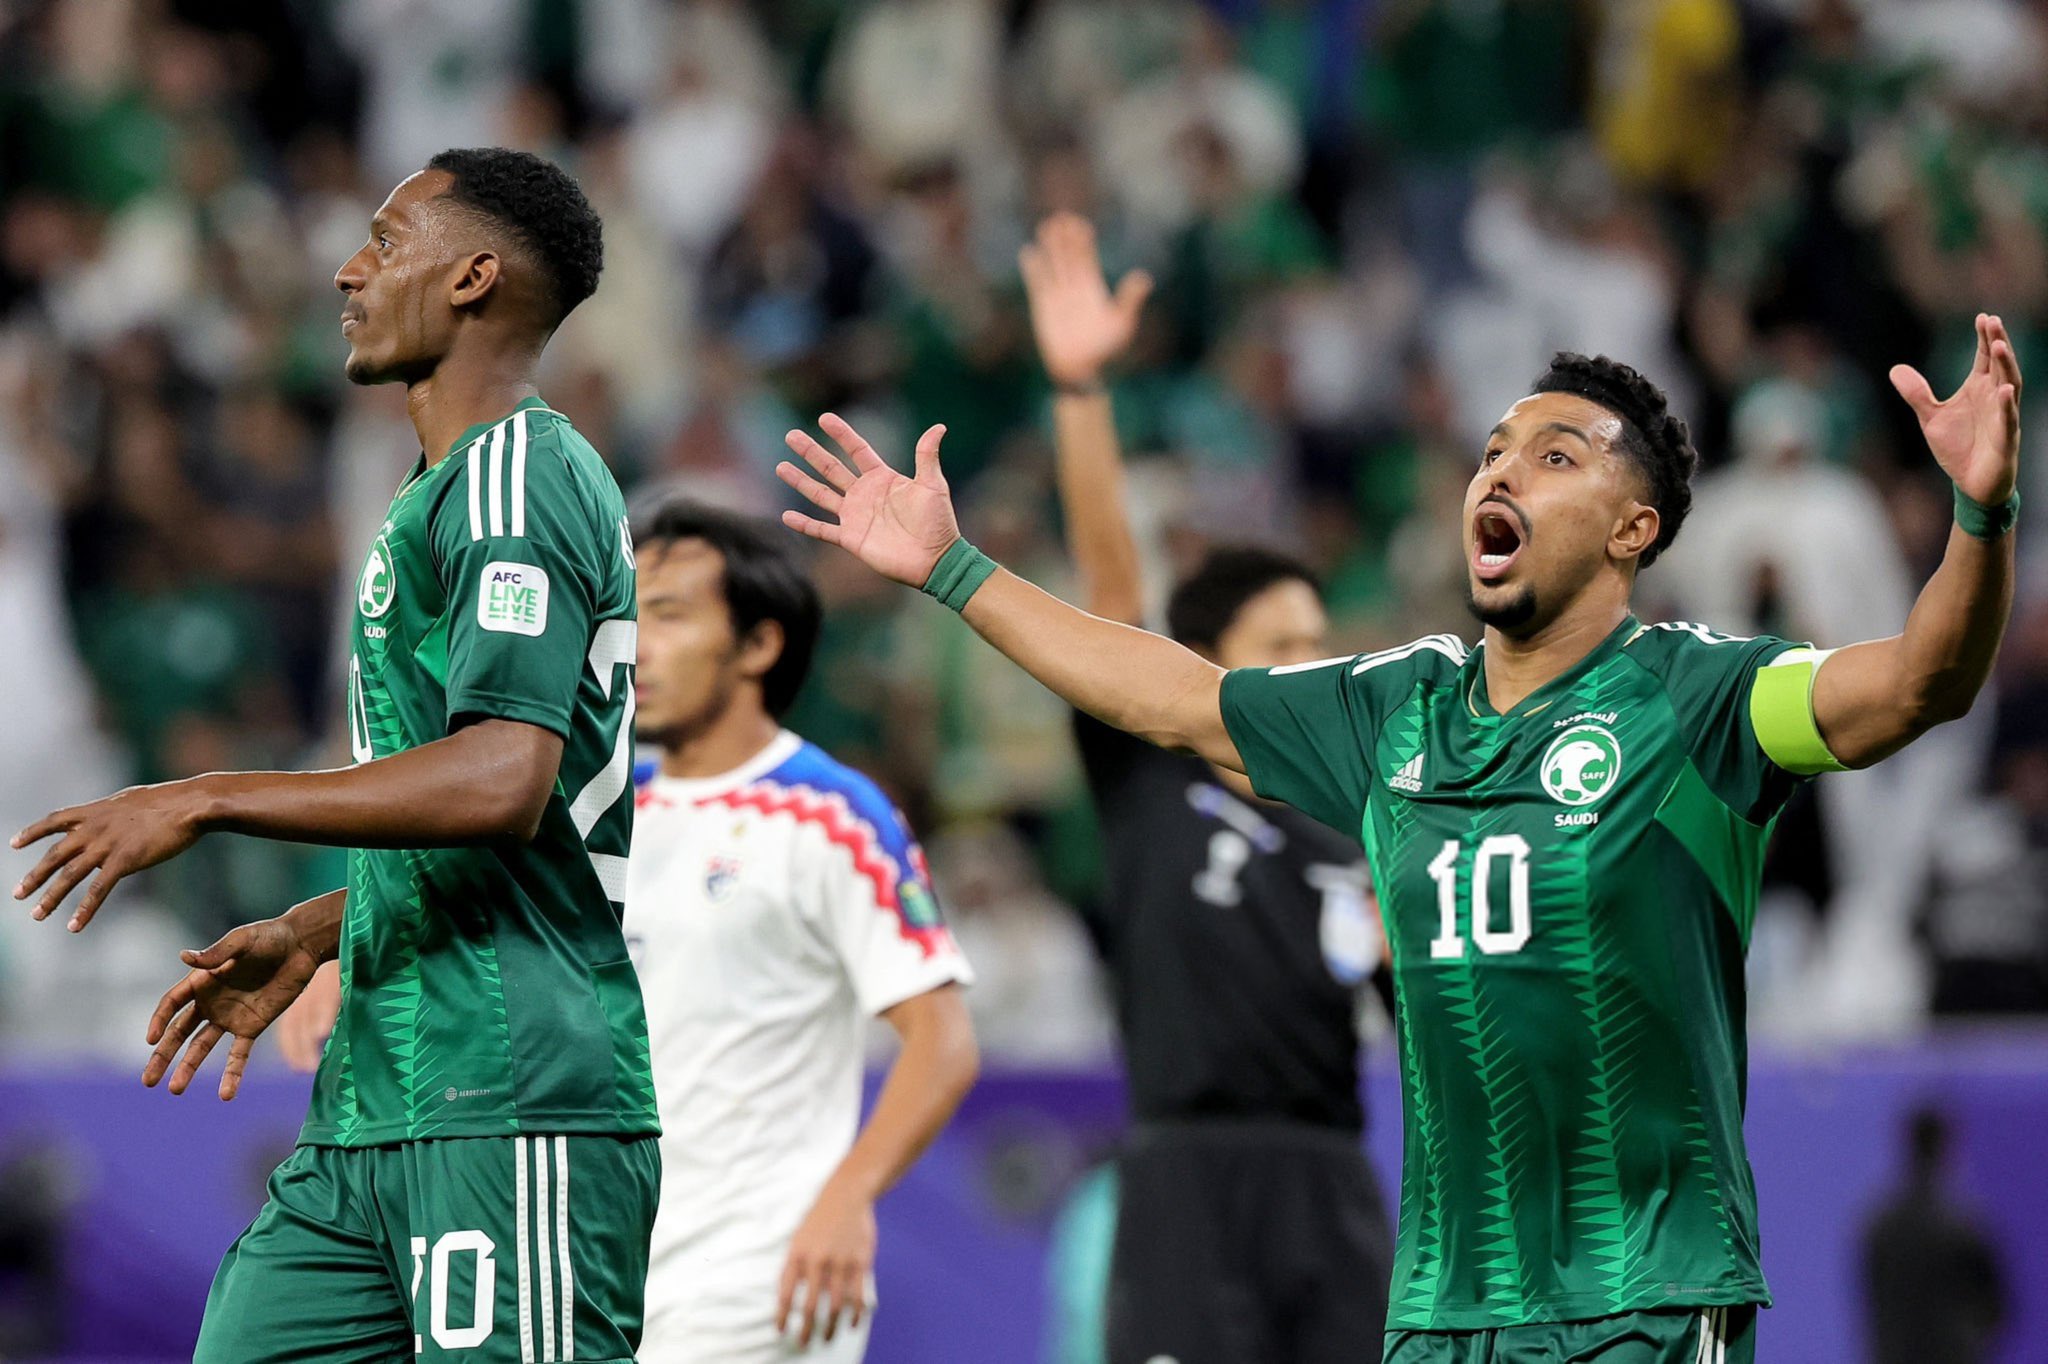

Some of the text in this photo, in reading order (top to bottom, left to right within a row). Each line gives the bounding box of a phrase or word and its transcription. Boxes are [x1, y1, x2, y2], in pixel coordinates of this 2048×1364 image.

[492, 571, 522, 584] AFC
[372, 585, 387, 594] SAFF
[490, 584, 538, 606] LIVE
[363, 625, 387, 639] UDI
[1581, 771, 1606, 780] SAFF
[1388, 775, 1423, 792] adidas
[1554, 812, 1599, 826] SAUDI
[1427, 834, 1532, 959] 10
